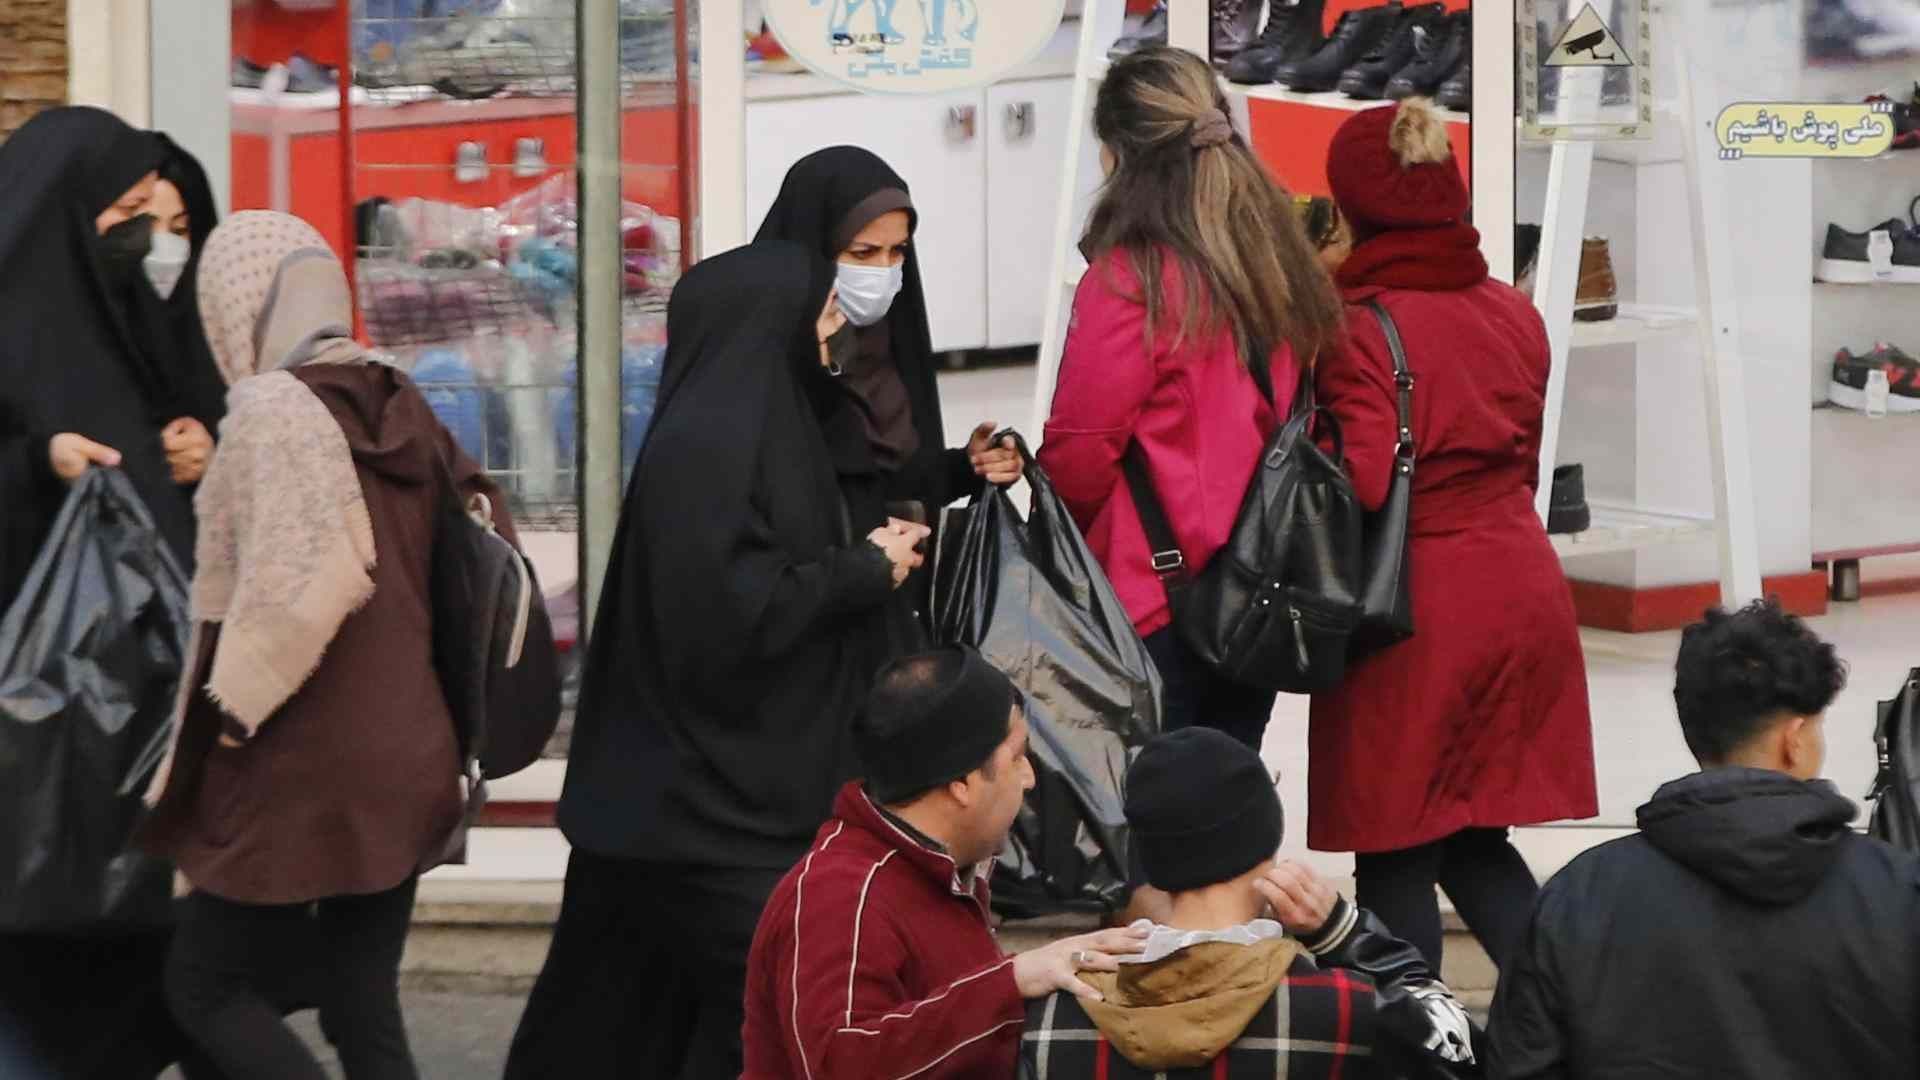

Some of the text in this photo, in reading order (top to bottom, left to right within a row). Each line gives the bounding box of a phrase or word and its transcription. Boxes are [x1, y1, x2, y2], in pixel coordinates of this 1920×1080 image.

[848, 53, 897, 77] ملی
[1726, 109, 1885, 149] ملی پوش باشیم
